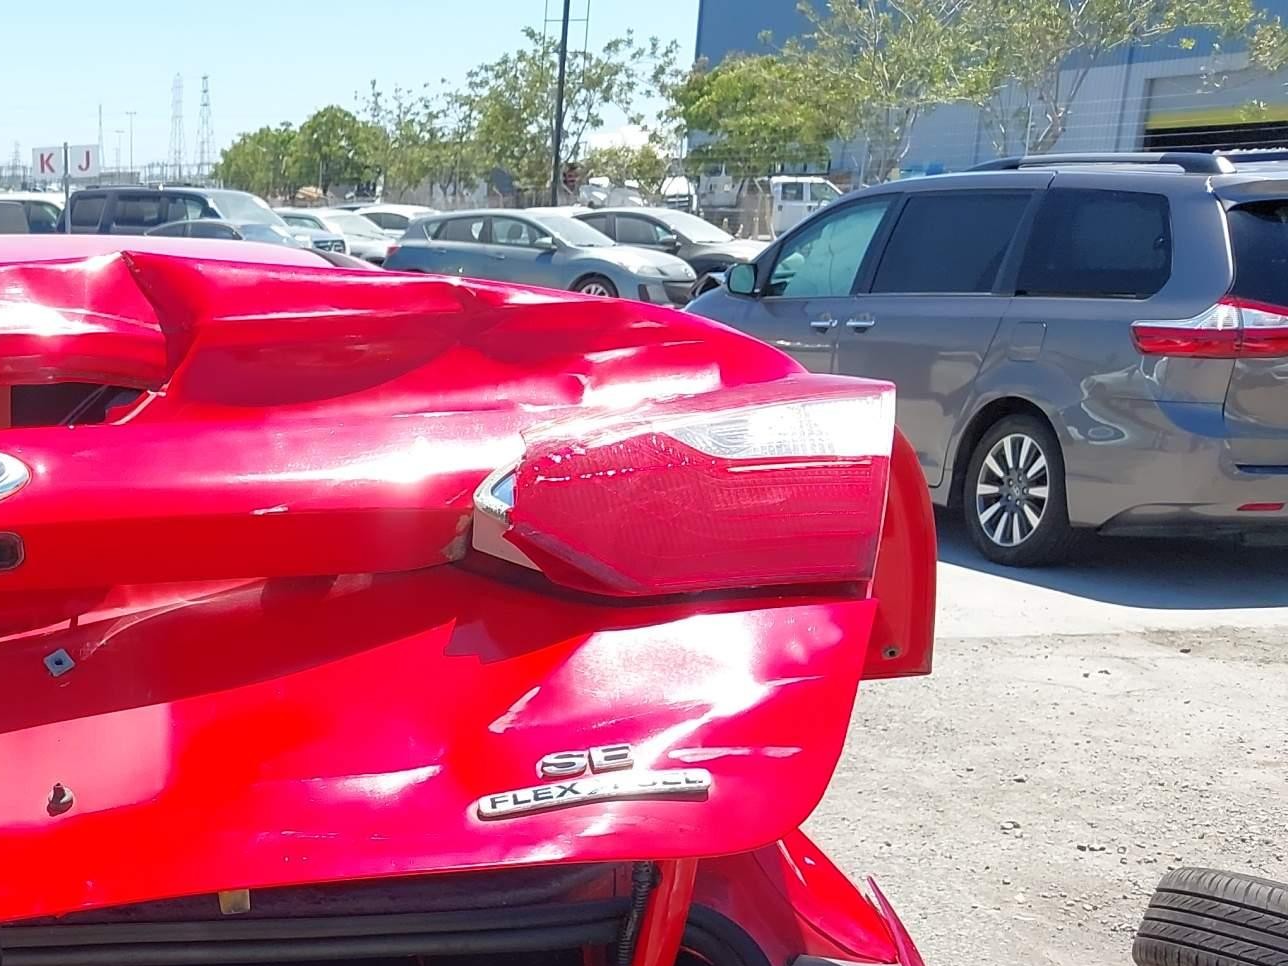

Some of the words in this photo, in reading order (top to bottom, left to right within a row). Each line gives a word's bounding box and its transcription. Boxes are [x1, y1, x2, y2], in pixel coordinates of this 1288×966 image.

[40, 152, 55, 174] K
[78, 150, 90, 172] J
[538, 743, 633, 777] SE
[489, 782, 581, 809] FLEX
